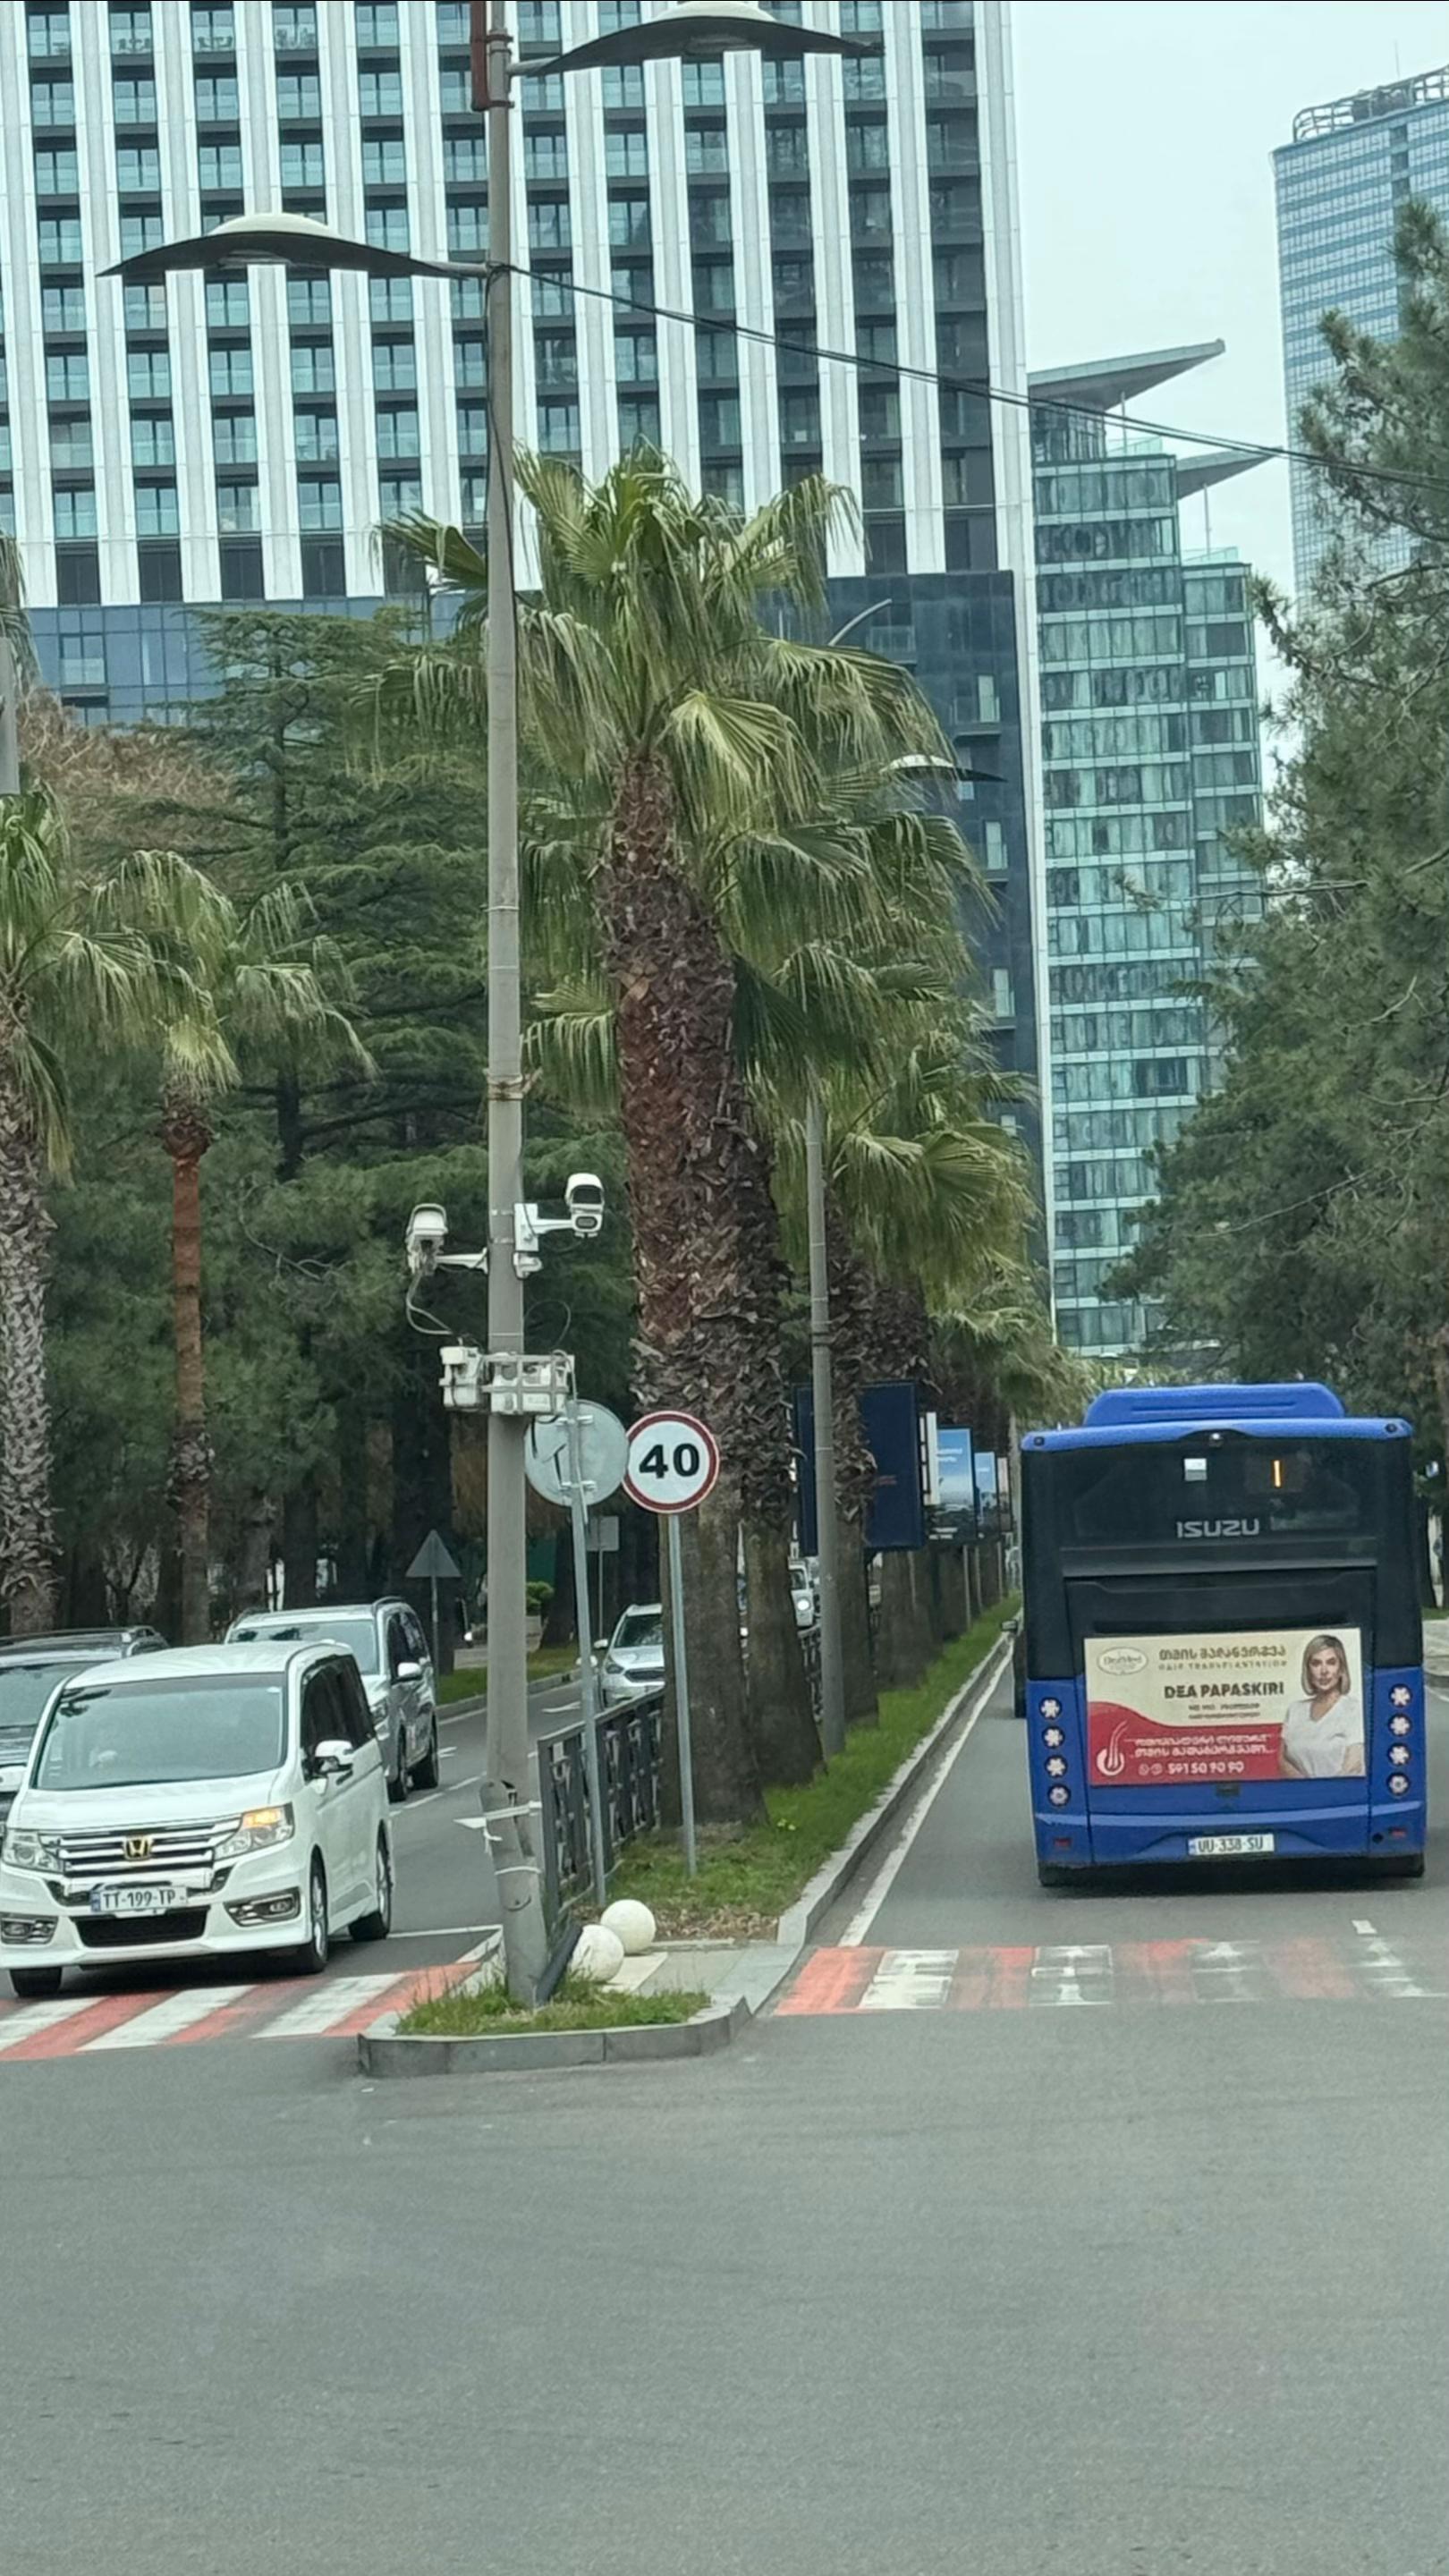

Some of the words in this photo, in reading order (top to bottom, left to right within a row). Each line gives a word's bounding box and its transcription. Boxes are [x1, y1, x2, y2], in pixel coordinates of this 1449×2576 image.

[639, 1443, 700, 1479] 40
[1176, 1519, 1259, 1538] ISUZU
[1165, 1685, 1198, 1699] DEA
[1200, 1682, 1284, 1697] PAPASKIRI
[1167, 1762, 1189, 1775] 591
[1191, 1762, 1208, 1775] 50
[103, 1888, 176, 1909] TT-199-TP
